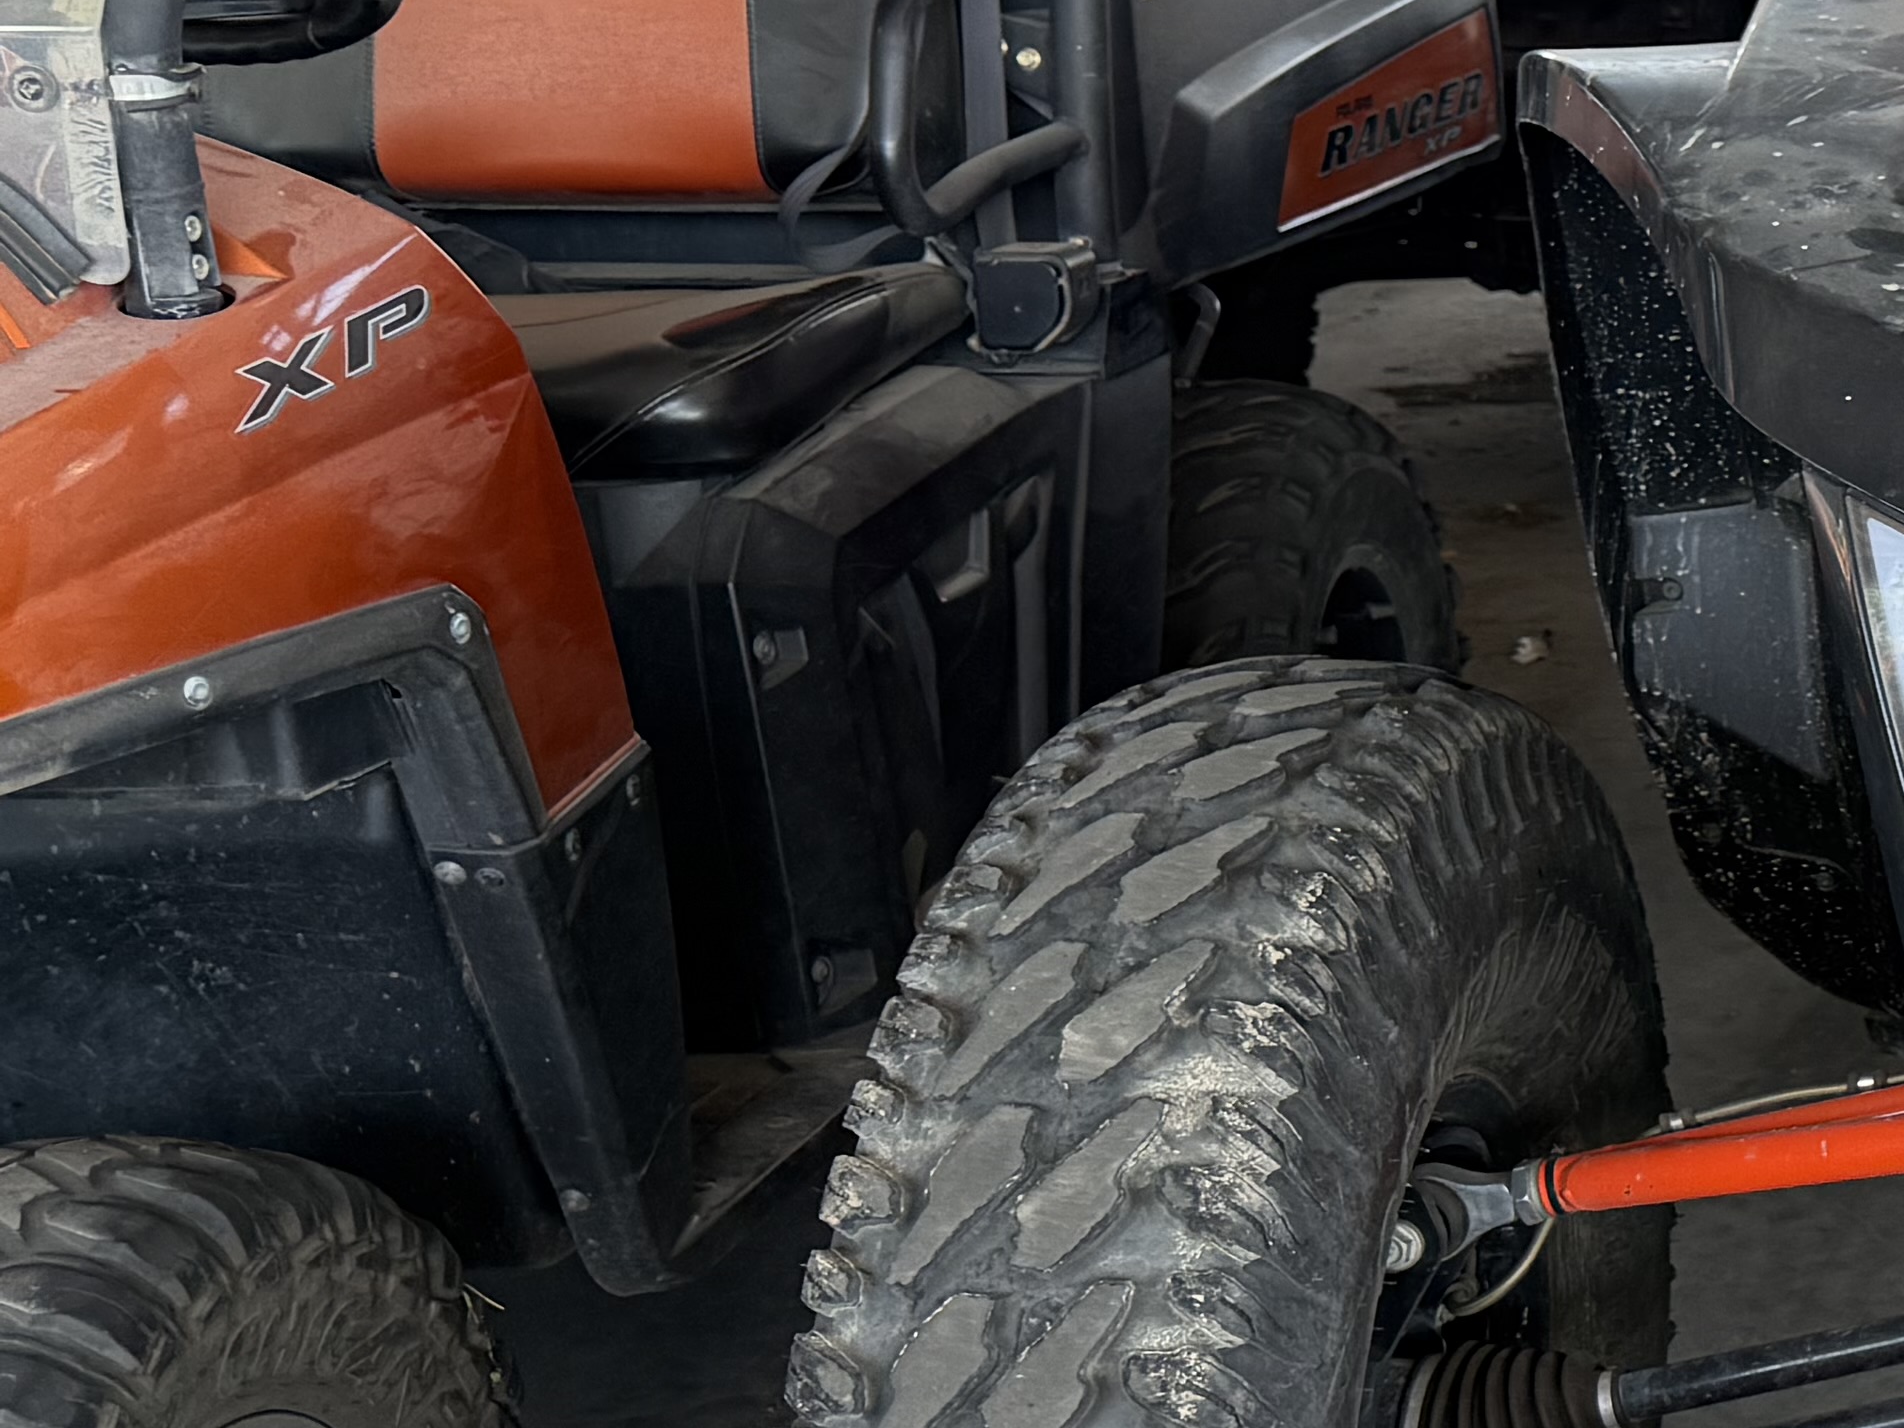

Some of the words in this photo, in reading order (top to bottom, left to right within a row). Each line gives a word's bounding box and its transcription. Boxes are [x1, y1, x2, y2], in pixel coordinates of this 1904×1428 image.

[1317, 69, 1484, 178] RANGER
[1423, 126, 1462, 156] XP
[234, 284, 430, 435] XP
